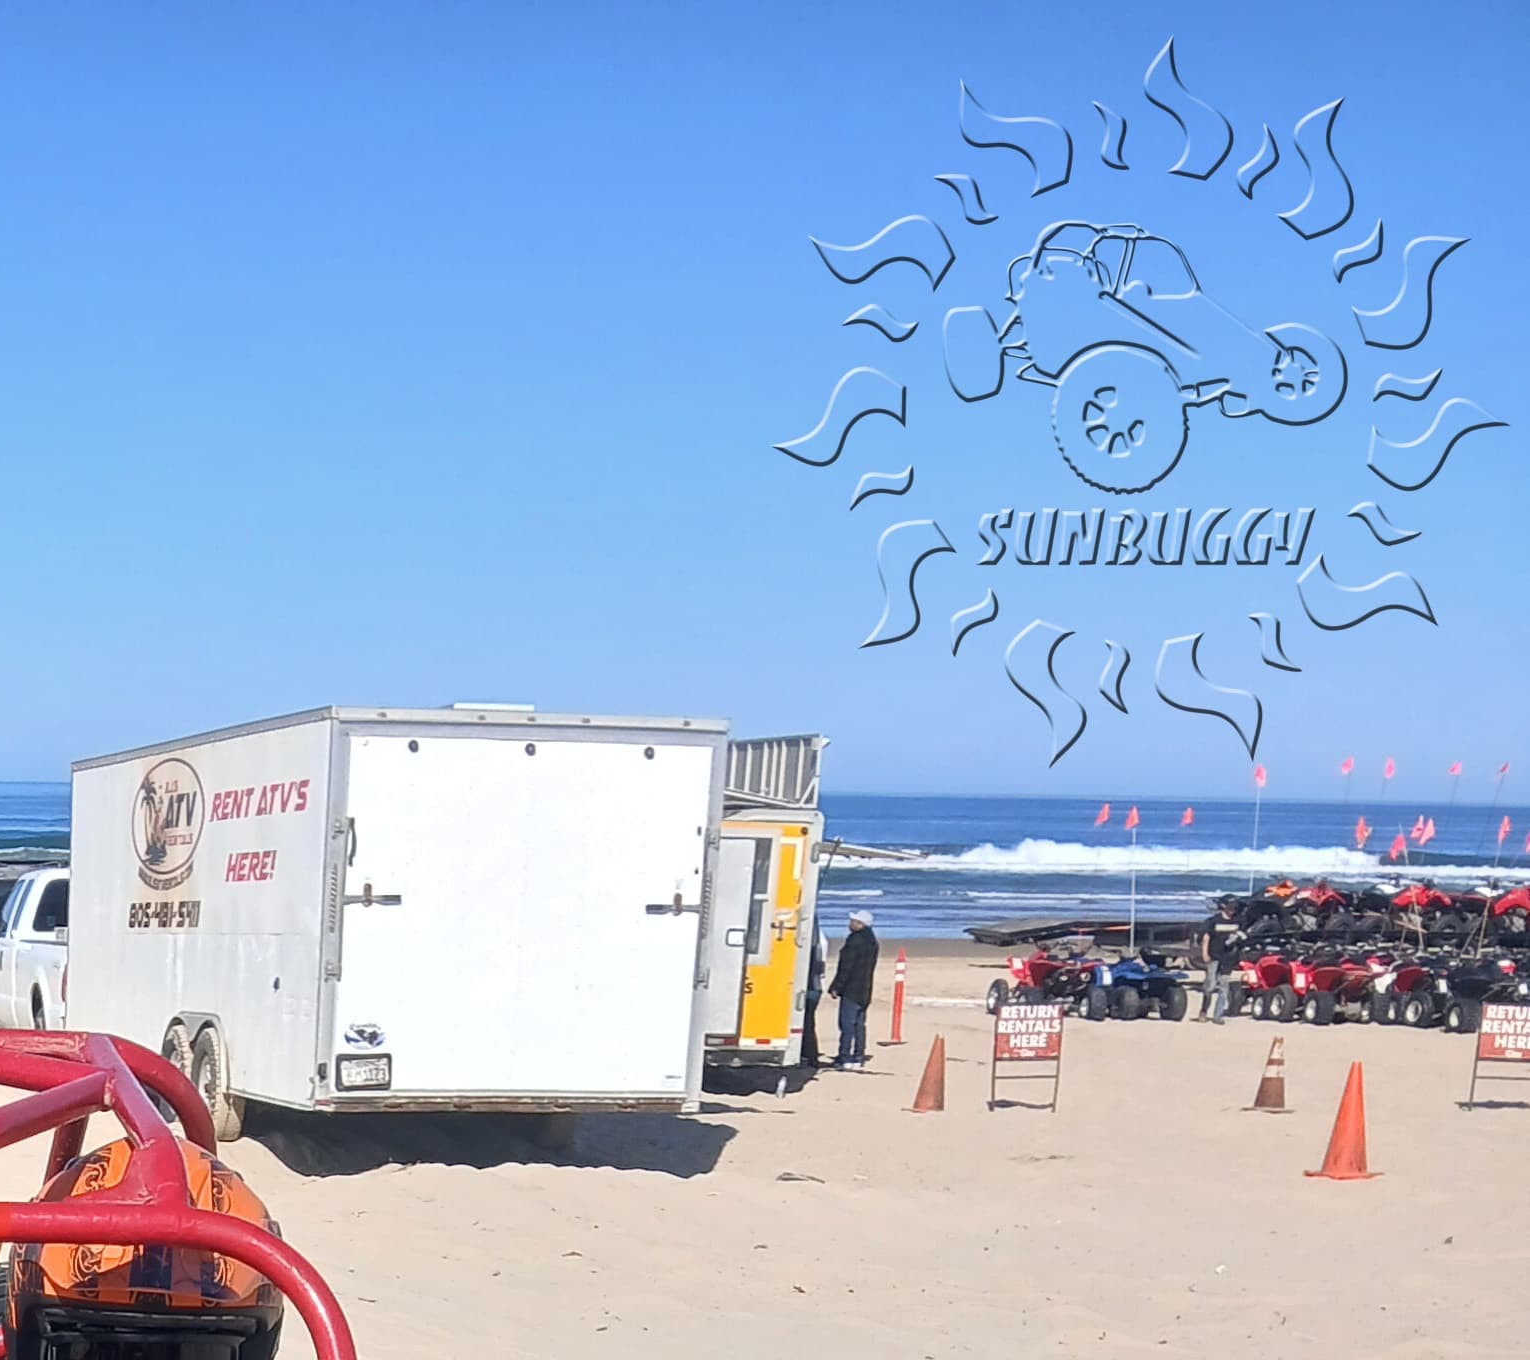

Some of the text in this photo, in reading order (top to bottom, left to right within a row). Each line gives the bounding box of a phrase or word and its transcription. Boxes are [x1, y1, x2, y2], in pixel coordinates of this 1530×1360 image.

[209, 779, 310, 823] RENT ATV'S
[162, 791, 197, 829] ATV
[225, 850, 277, 882] HERE!
[1000, 1005, 1060, 1018] RETURN
[1486, 1005, 1530, 1019] RETU
[997, 1019, 1061, 1033] RENTALS
[1481, 1020, 1530, 1034] RENTA
[1010, 1034, 1047, 1048] HERE
